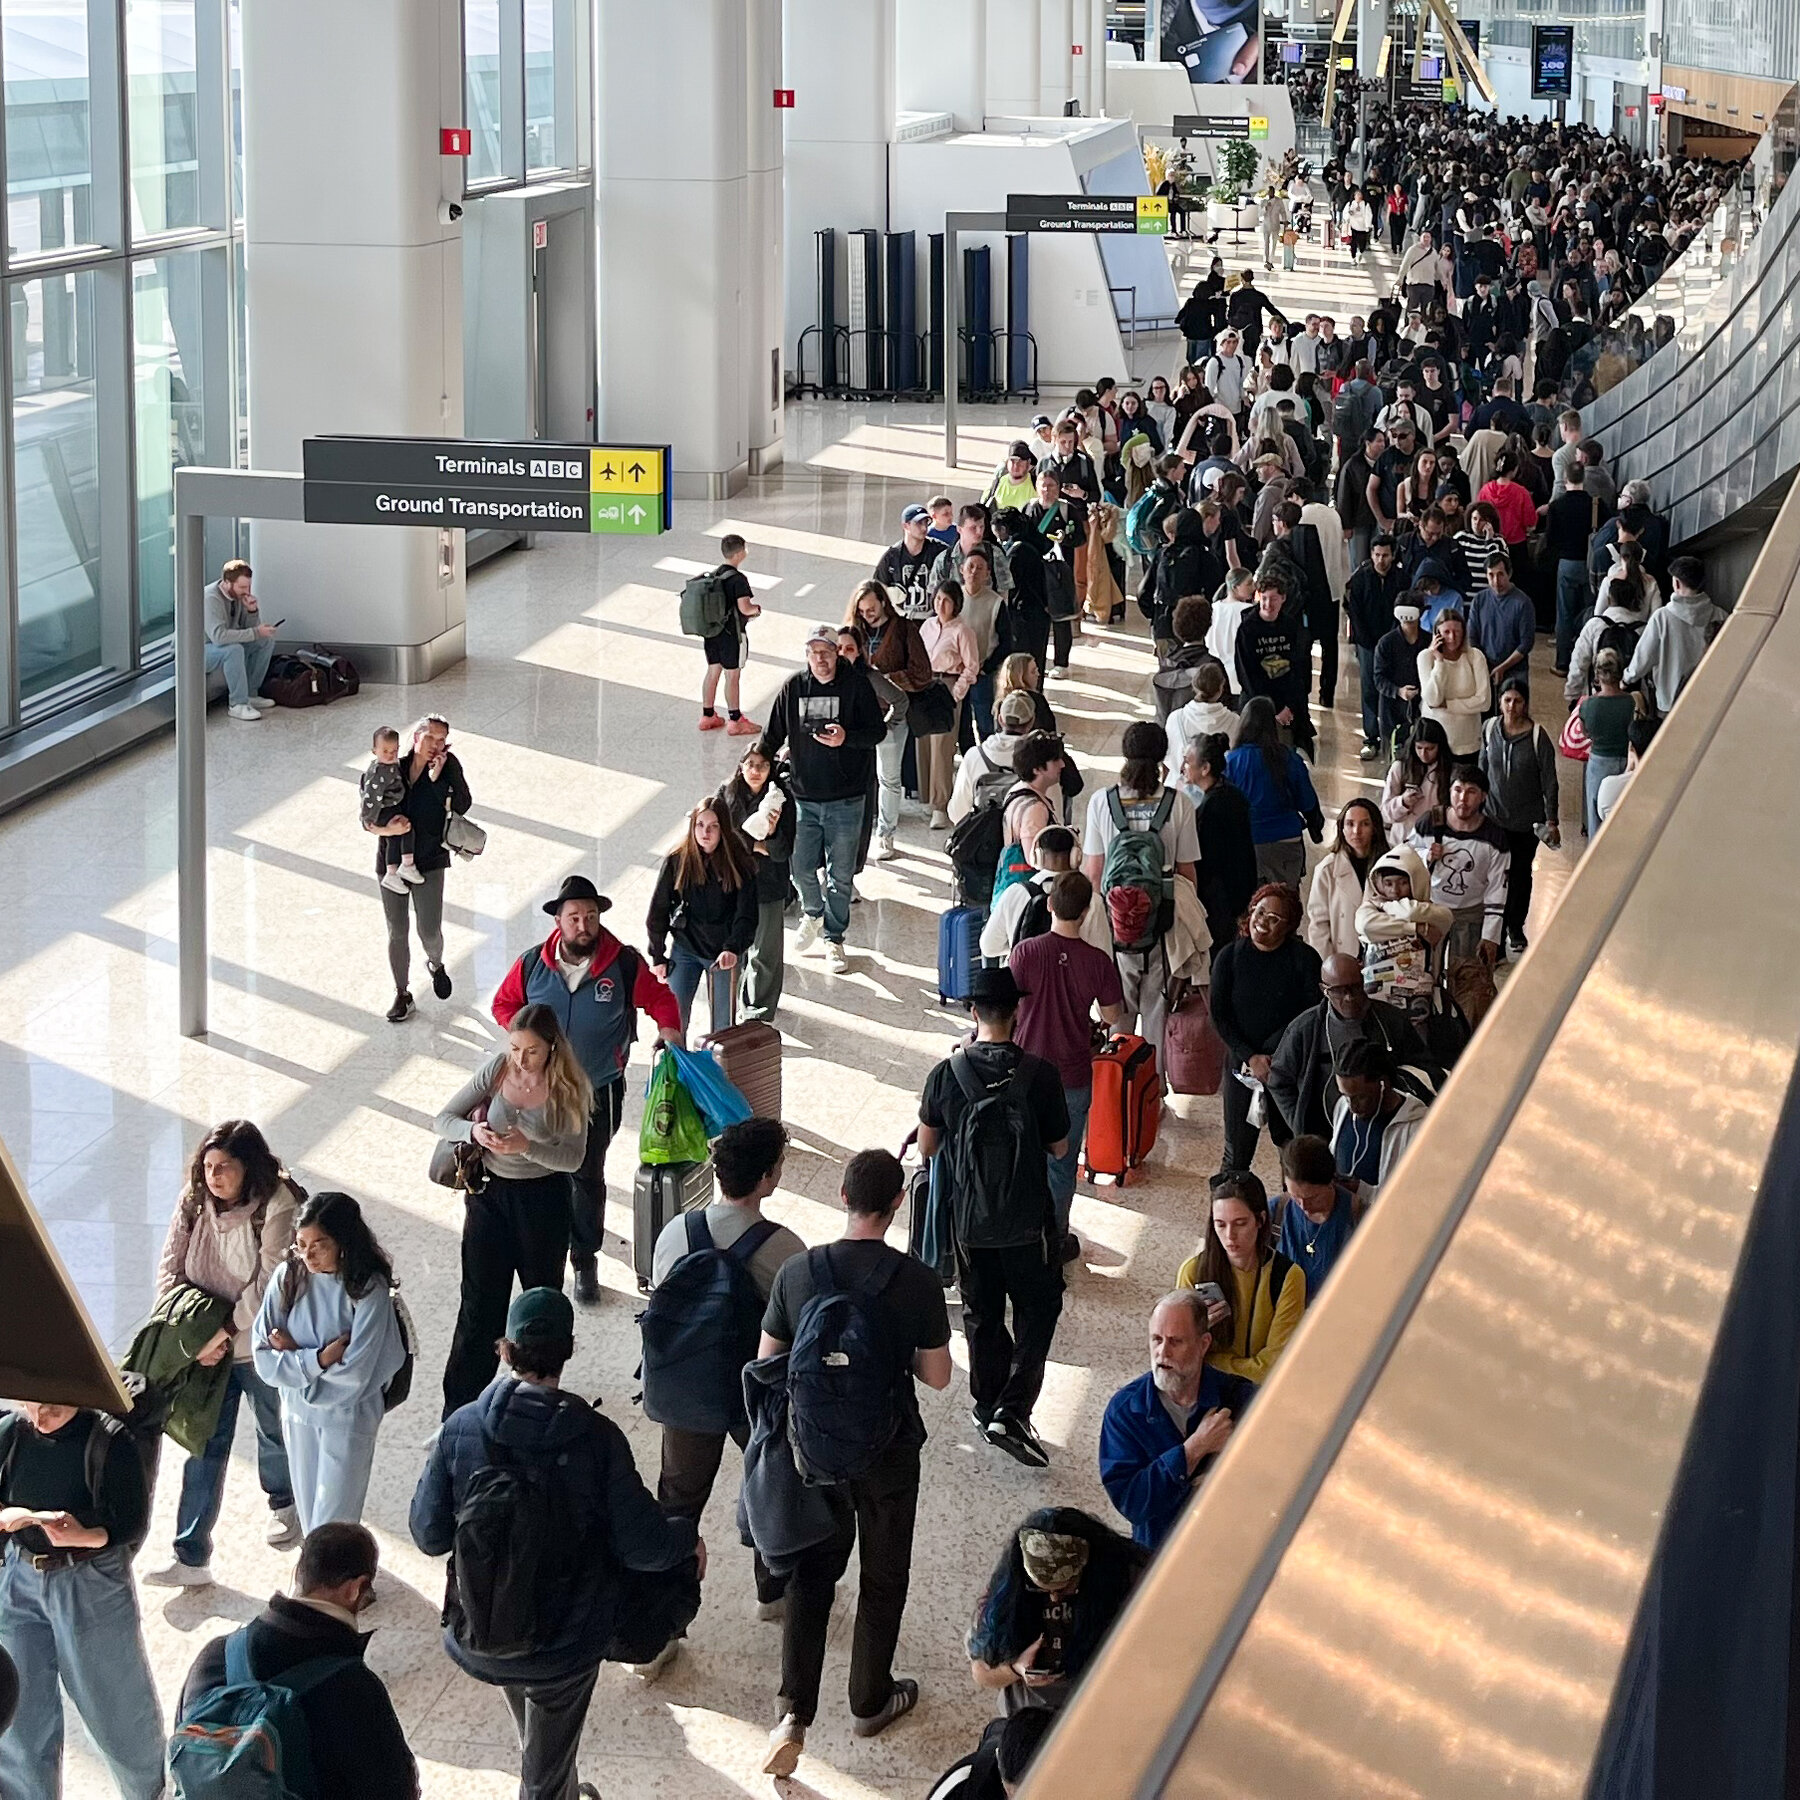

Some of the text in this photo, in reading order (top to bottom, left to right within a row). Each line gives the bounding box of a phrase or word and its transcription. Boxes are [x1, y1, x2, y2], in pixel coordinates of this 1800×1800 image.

[1067, 202, 1108, 211] Terminals
[1039, 220, 1134, 230] Ground Transportation
[435, 455, 526, 476] Terminals
[375, 494, 583, 520] Ground Transportation
[1043, 1602, 1073, 1619] uck
